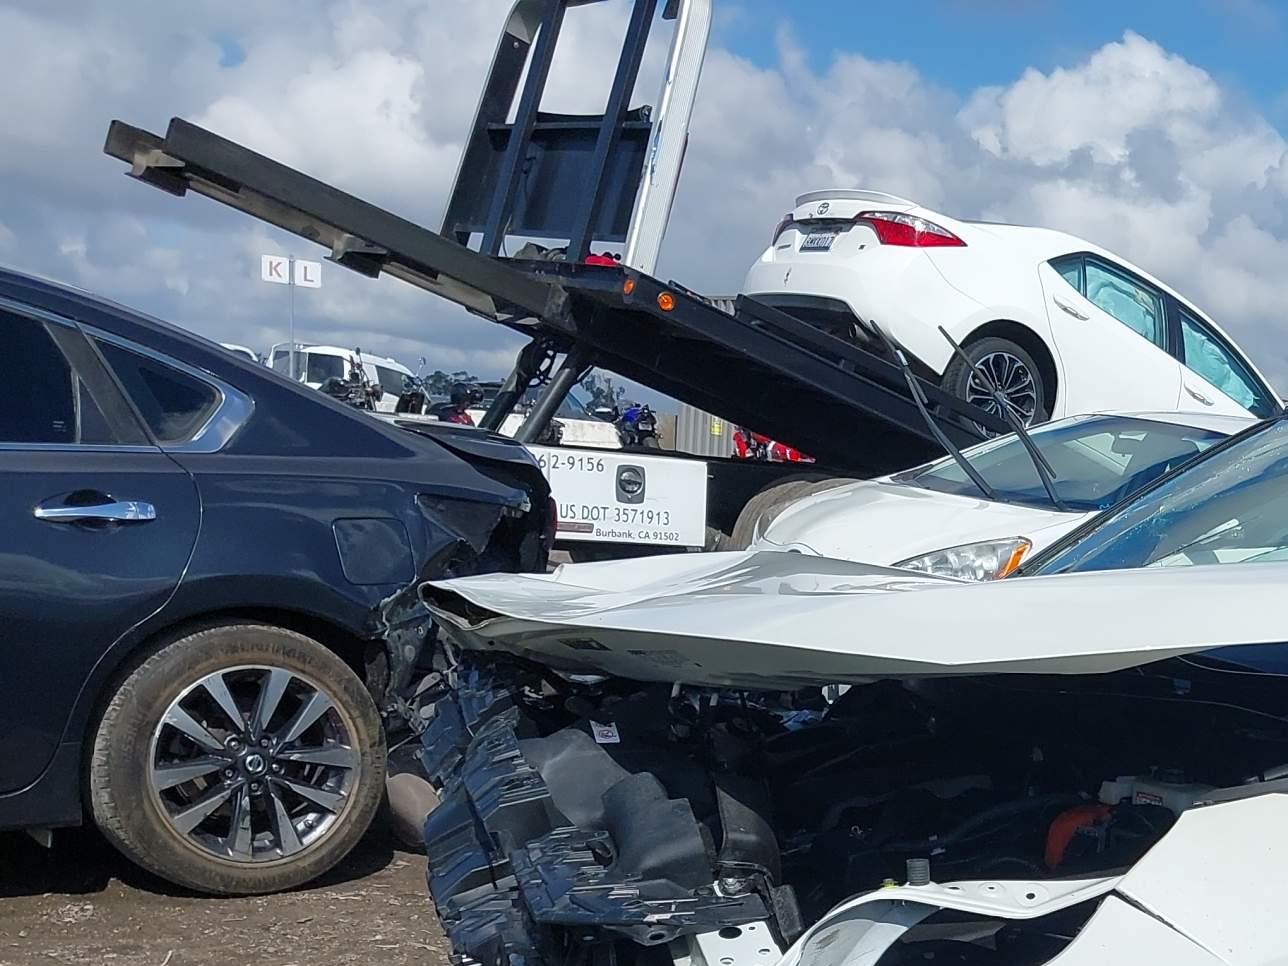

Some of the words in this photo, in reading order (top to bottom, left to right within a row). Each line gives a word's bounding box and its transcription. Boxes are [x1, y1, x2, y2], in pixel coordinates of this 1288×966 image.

[269, 261, 282, 278] K
[303, 266, 314, 282] L
[560, 503, 576, 519] US
[581, 505, 609, 521] DOT
[614, 507, 670, 526] 3571913
[595, 528, 635, 540] Burbank,
[638, 530, 650, 540] CA
[652, 531, 680, 541] 91502
